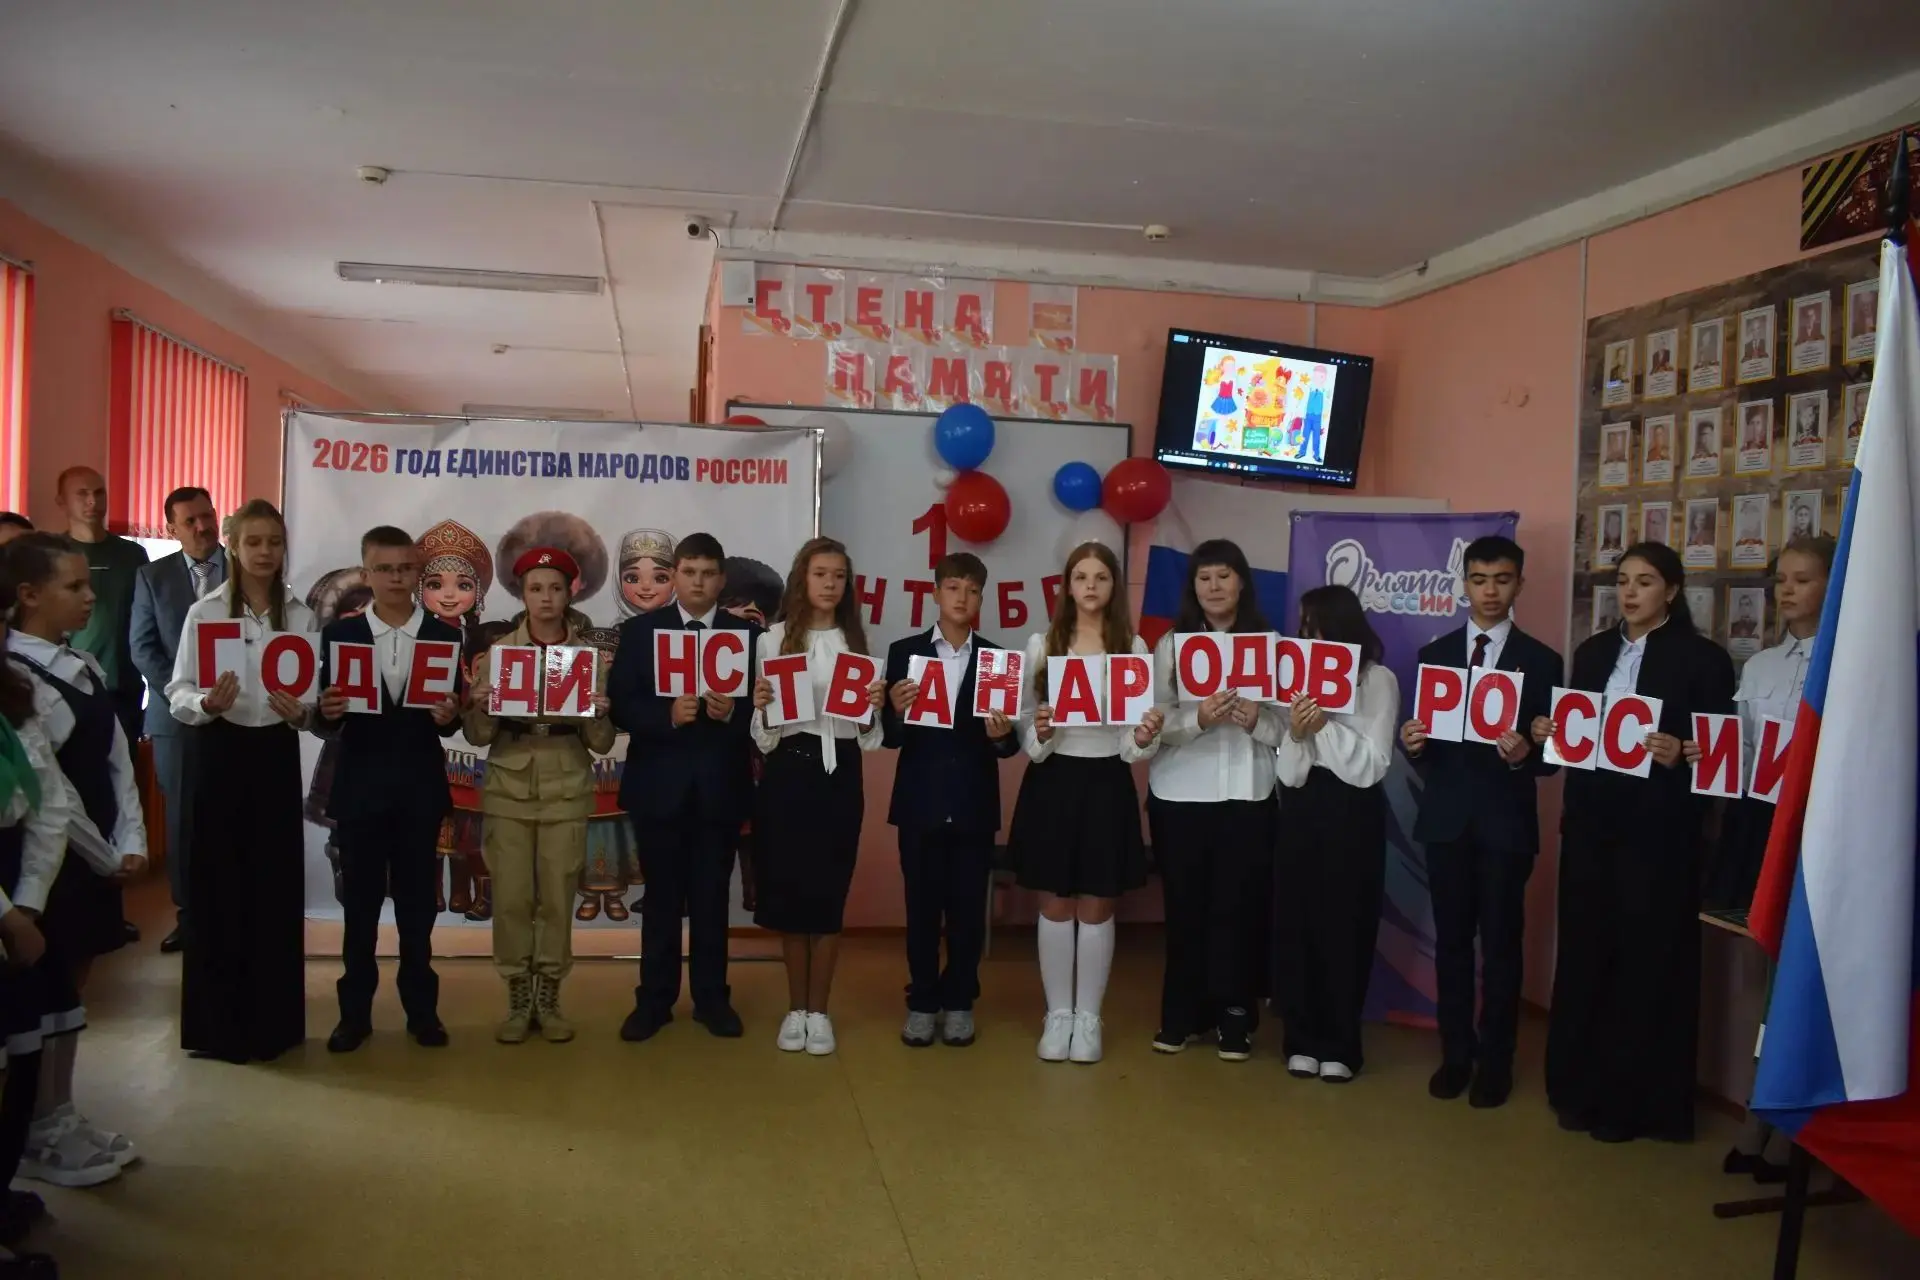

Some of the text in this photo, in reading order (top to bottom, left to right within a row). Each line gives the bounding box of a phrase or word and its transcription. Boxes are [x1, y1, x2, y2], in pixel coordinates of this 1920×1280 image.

[755, 280, 983, 335] СТЕНА
[834, 352, 1108, 407] ПАМЯТИ
[312, 438, 788, 485] 2026 ГОД ЕДИНСТВА НАРОДОВ РОССИИ
[912, 503, 948, 570] 1
[1328, 541, 1456, 597] Орлята
